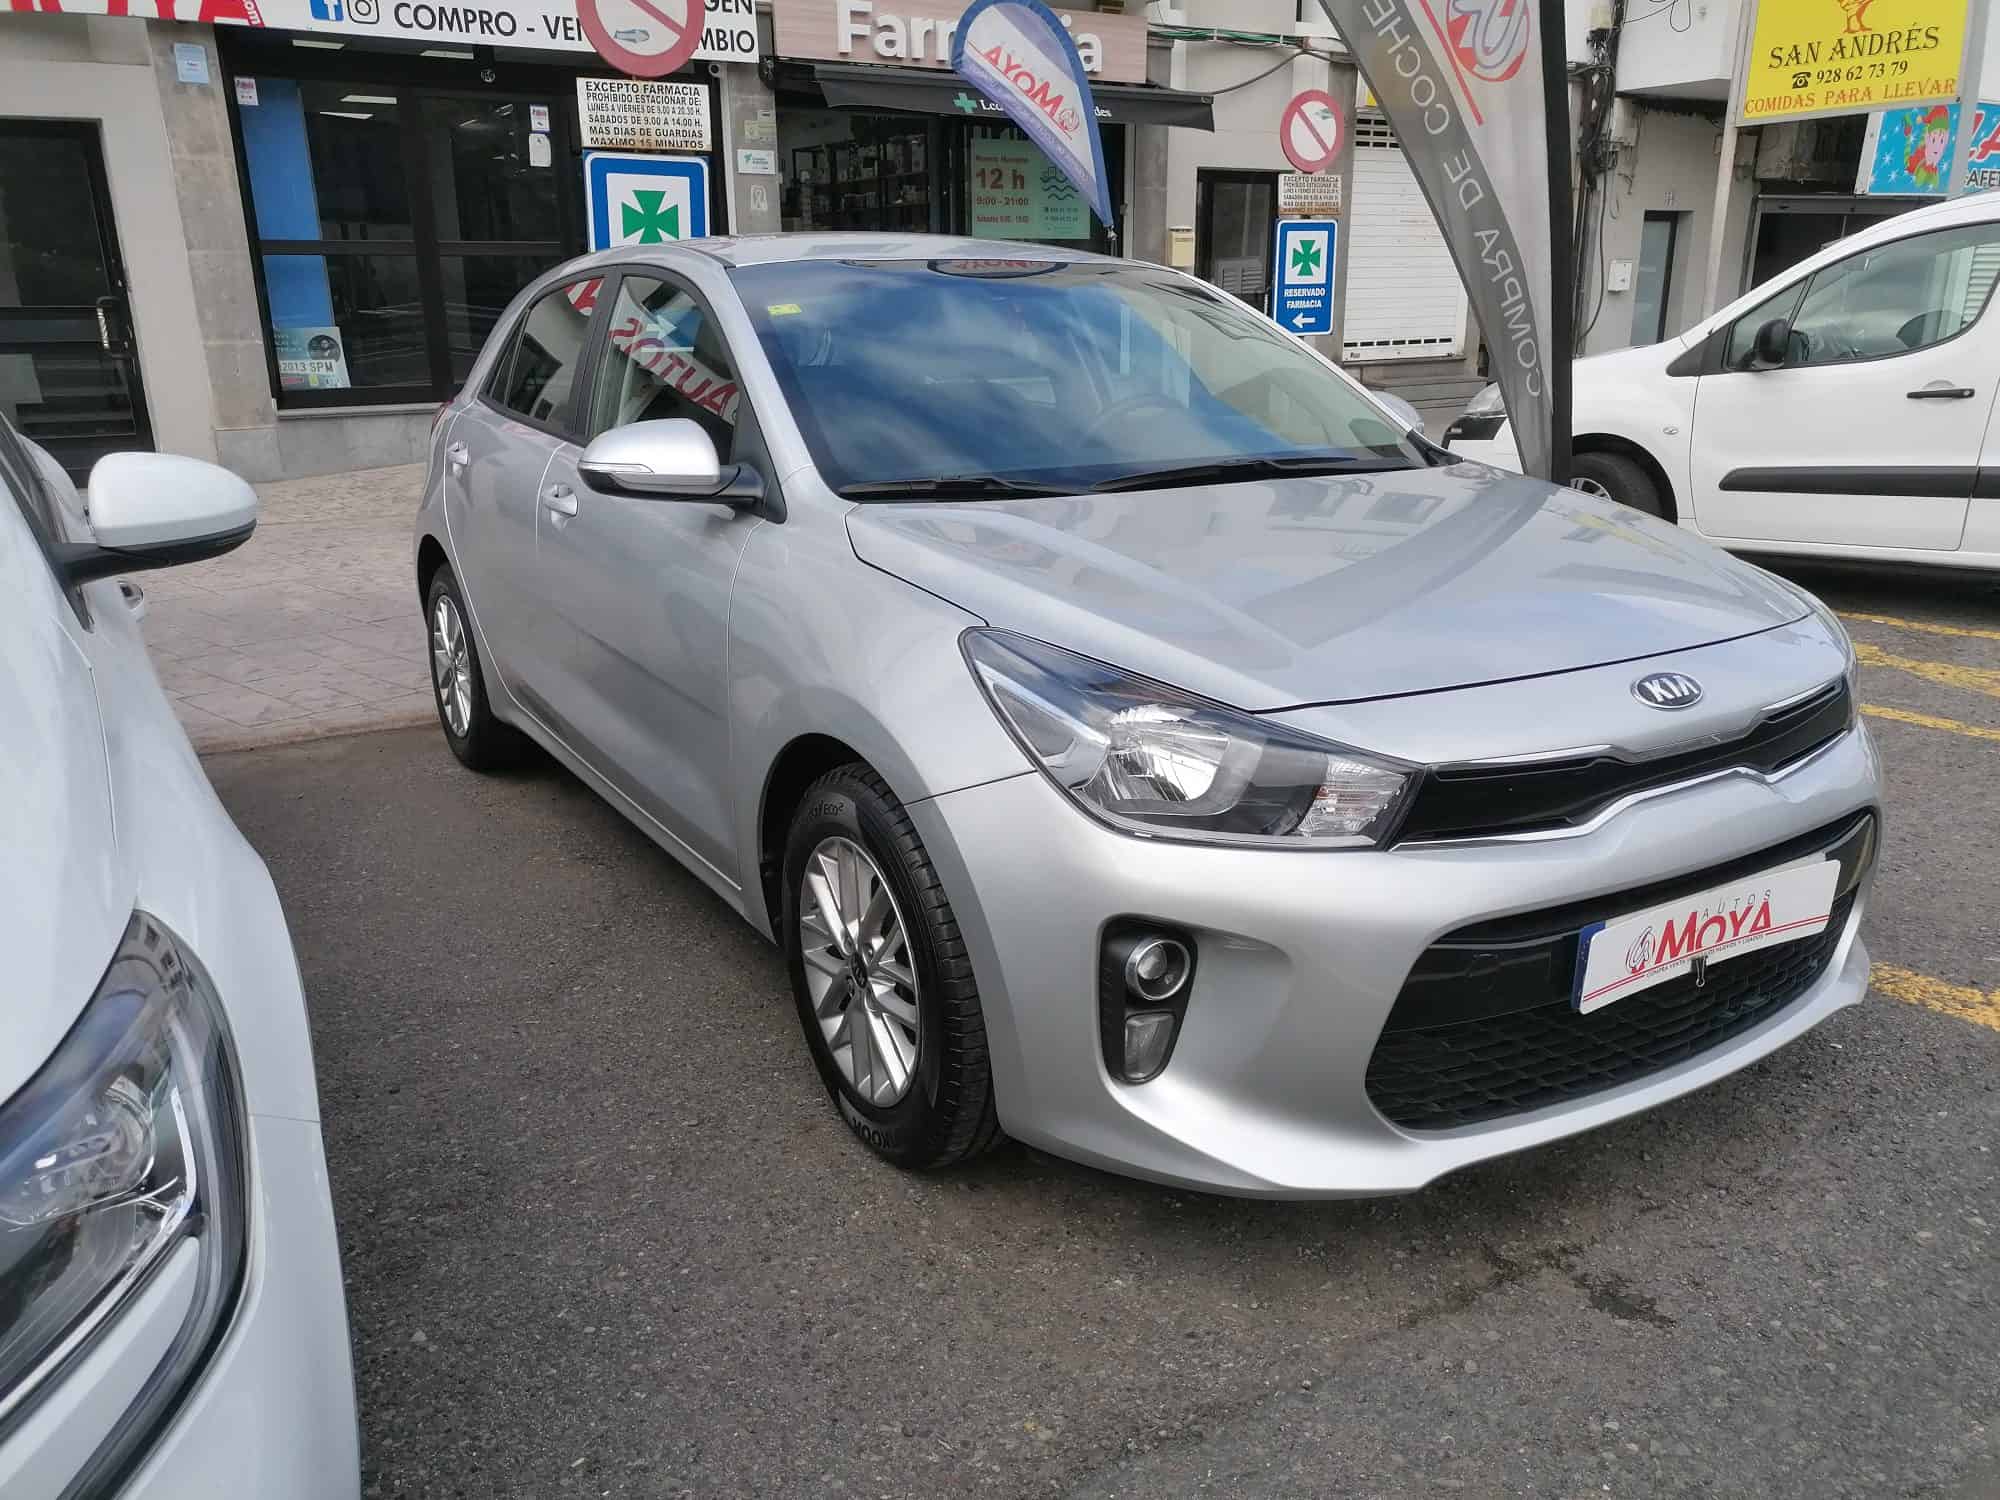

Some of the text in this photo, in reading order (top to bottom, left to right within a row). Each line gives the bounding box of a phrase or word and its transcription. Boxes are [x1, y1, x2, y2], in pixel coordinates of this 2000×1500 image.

[394, 3, 517, 37] COMPRO
[1768, 23, 1941, 69] SAN ANDRÉS
[1816, 60, 1909, 85] 928 62 73 79
[586, 81, 701, 97] EXCEPTO FARMACIA
[1745, 78, 1957, 114] COMIDAS PARA LLEVAR
[586, 92, 633, 103] PROHIBIDO
[635, 94, 687, 106] ESTACIONAR
[587, 103, 609, 112] LUNES
[611, 104, 616, 112] A
[617, 104, 645, 114] VIERNES
[646, 105, 655, 114] DE
[671, 107, 676, 115] A
[631, 115, 642, 125] DE
[644, 116, 660, 126] 9.00
[663, 117, 669, 126] A
[671, 117, 692, 127] 14.00
[640, 128, 652, 137] DE
[655, 128, 703, 139] GUARDIAS
[655, 139, 704, 149] MINUTOS
[976, 167, 1026, 190] 12 h
[1284, 287, 1326, 297] RESERVADO
[1286, 299, 1322, 309] FARMACIA
[1640, 675, 1699, 702] KIA
[1654, 900, 1772, 965] MOYA
